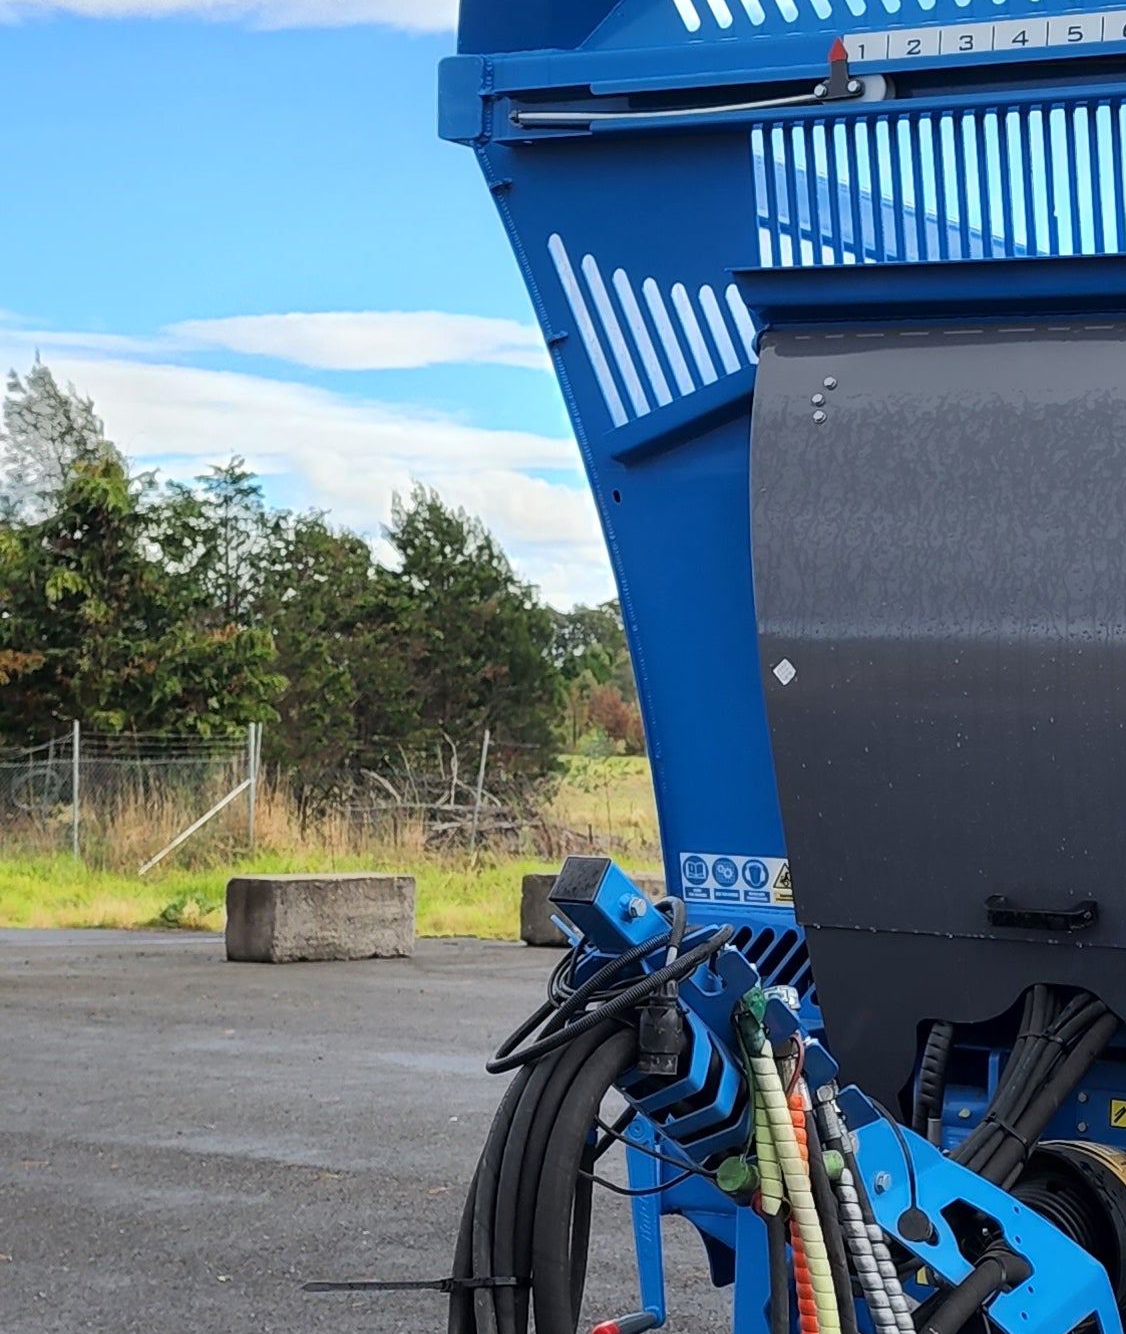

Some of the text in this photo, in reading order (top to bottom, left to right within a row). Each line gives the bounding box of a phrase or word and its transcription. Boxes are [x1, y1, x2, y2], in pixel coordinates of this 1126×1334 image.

[858, 44, 865, 60] 1
[906, 39, 922, 55] 2
[959, 35, 974, 51] 3
[1012, 30, 1029, 46] 4
[1067, 26, 1084, 42] 5
